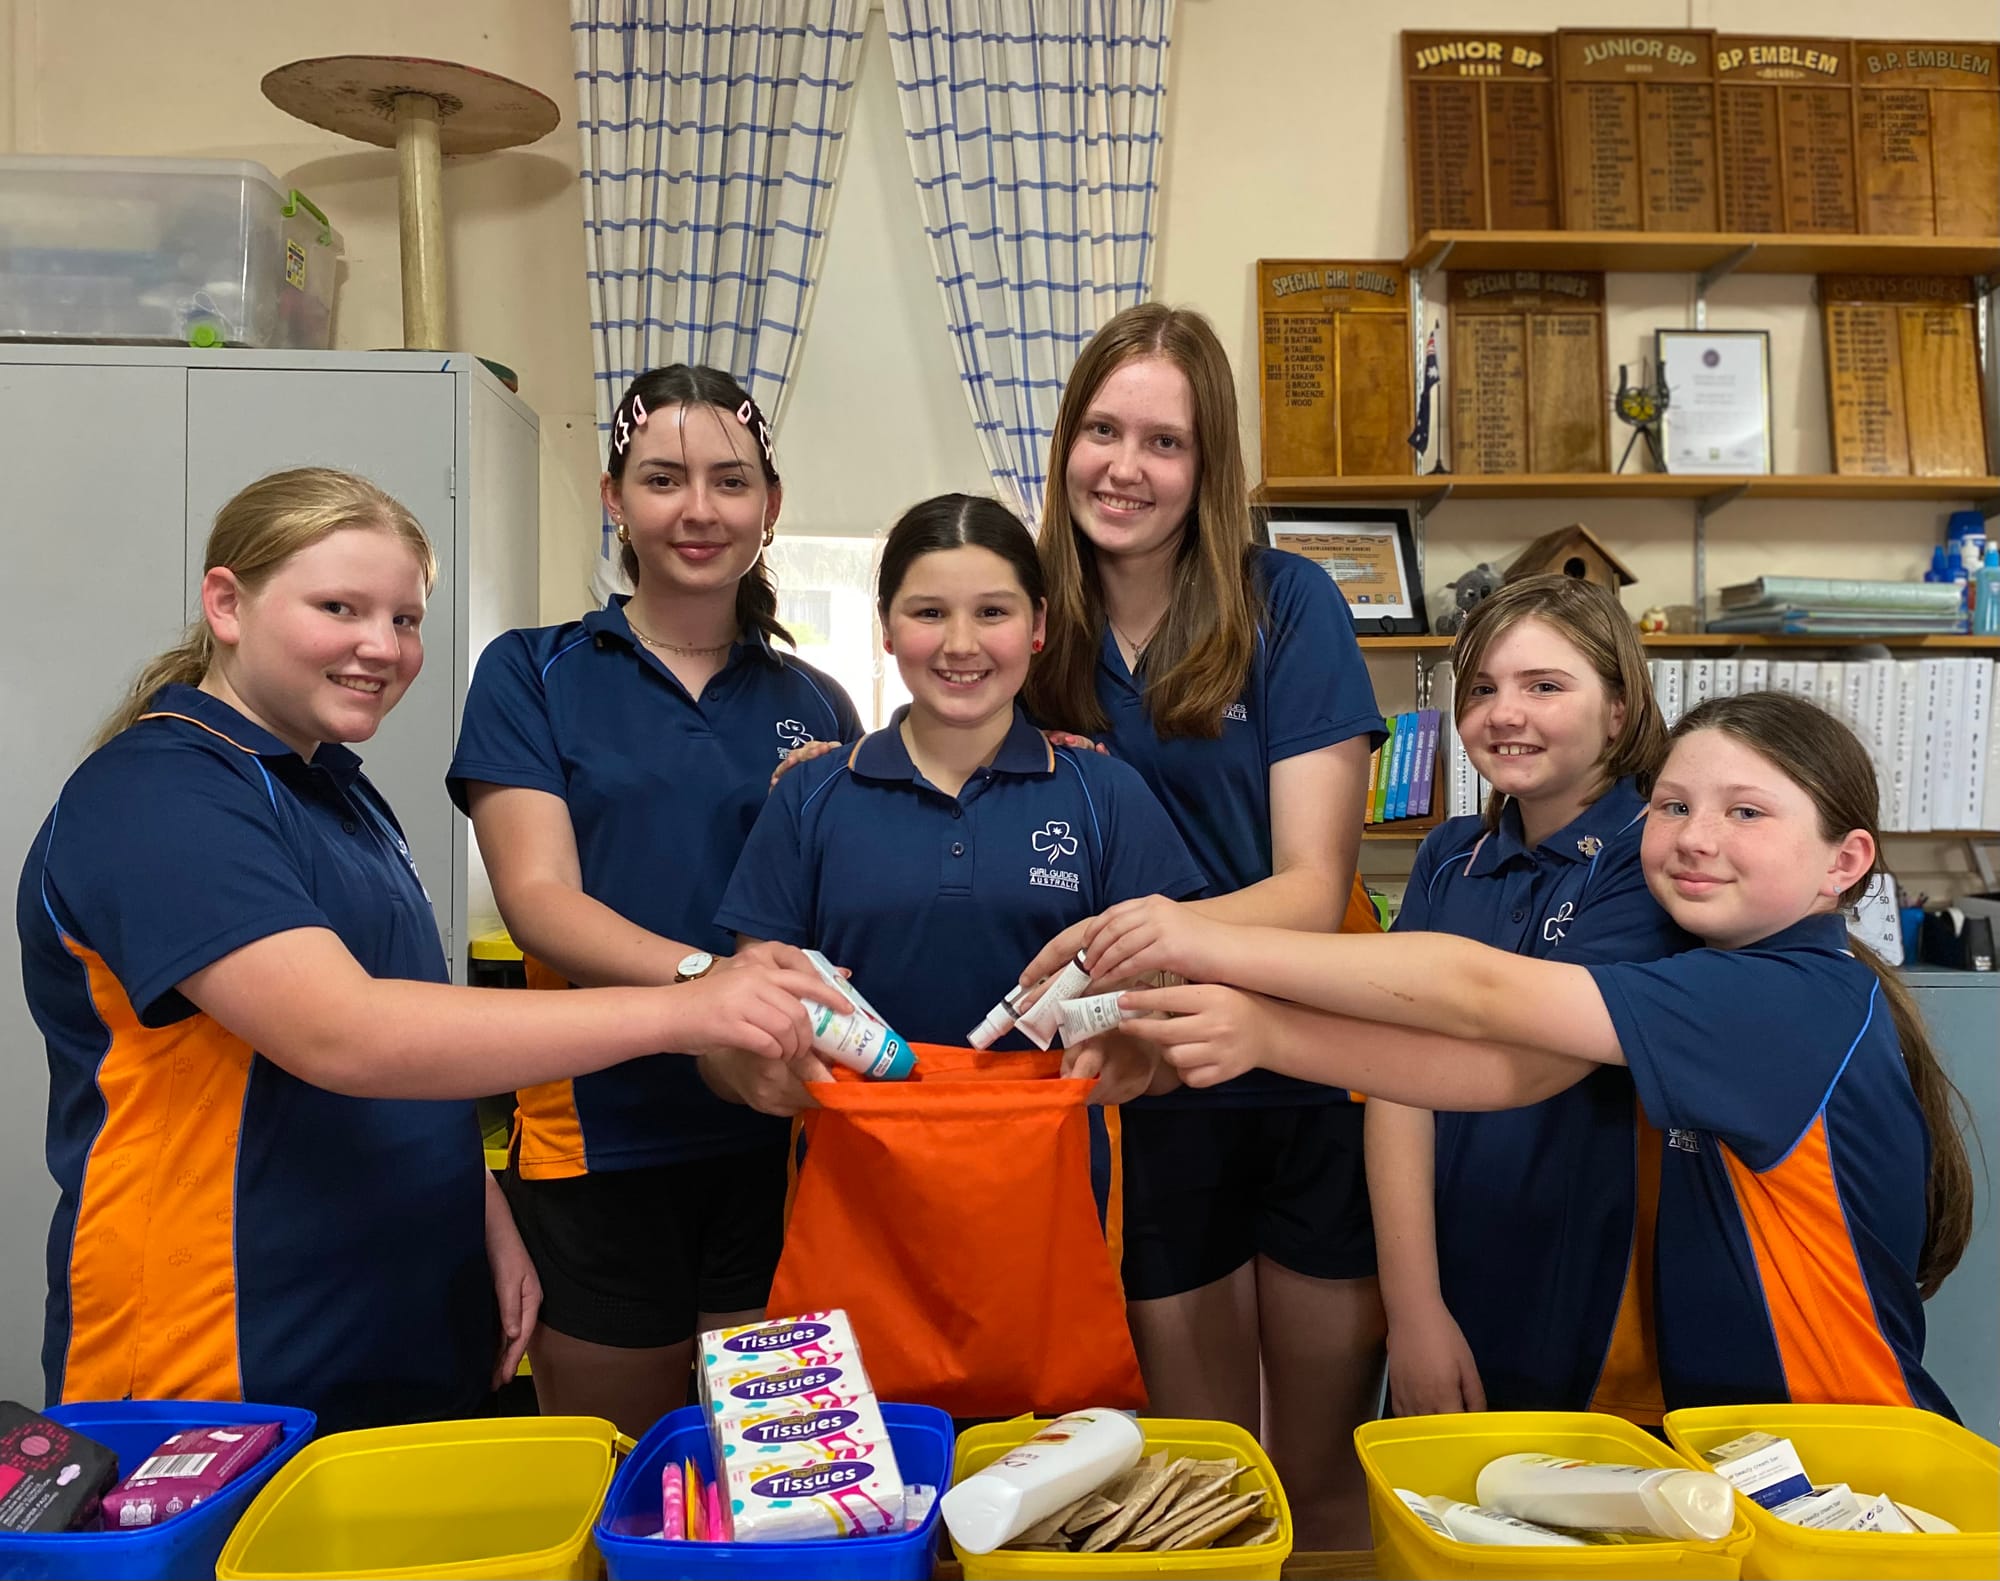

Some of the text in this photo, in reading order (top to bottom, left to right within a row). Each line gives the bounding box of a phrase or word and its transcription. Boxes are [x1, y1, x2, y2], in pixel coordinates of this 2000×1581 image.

[1415, 41, 1543, 70] JUNIOR BP
[1584, 37, 1697, 67] JUNIOR BP
[1749, 46, 1839, 75] EMBLEM
[1906, 49, 1991, 75] EMBLEM
[1272, 270, 1397, 297] SPECIAL GIRL GUIDES
[1029, 867, 1079, 882] GIRL GUIDES
[1029, 875, 1079, 890] AUSTRALIA
[1879, 896, 1889, 905] 50
[1885, 914, 1895, 923] 45
[1883, 933, 1894, 942] 40
[738, 1325, 816, 1350] Tissues
[746, 1370, 826, 1397] Tissues
[758, 1414, 842, 1441] Tissues
[768, 1466, 856, 1495] Tissues
